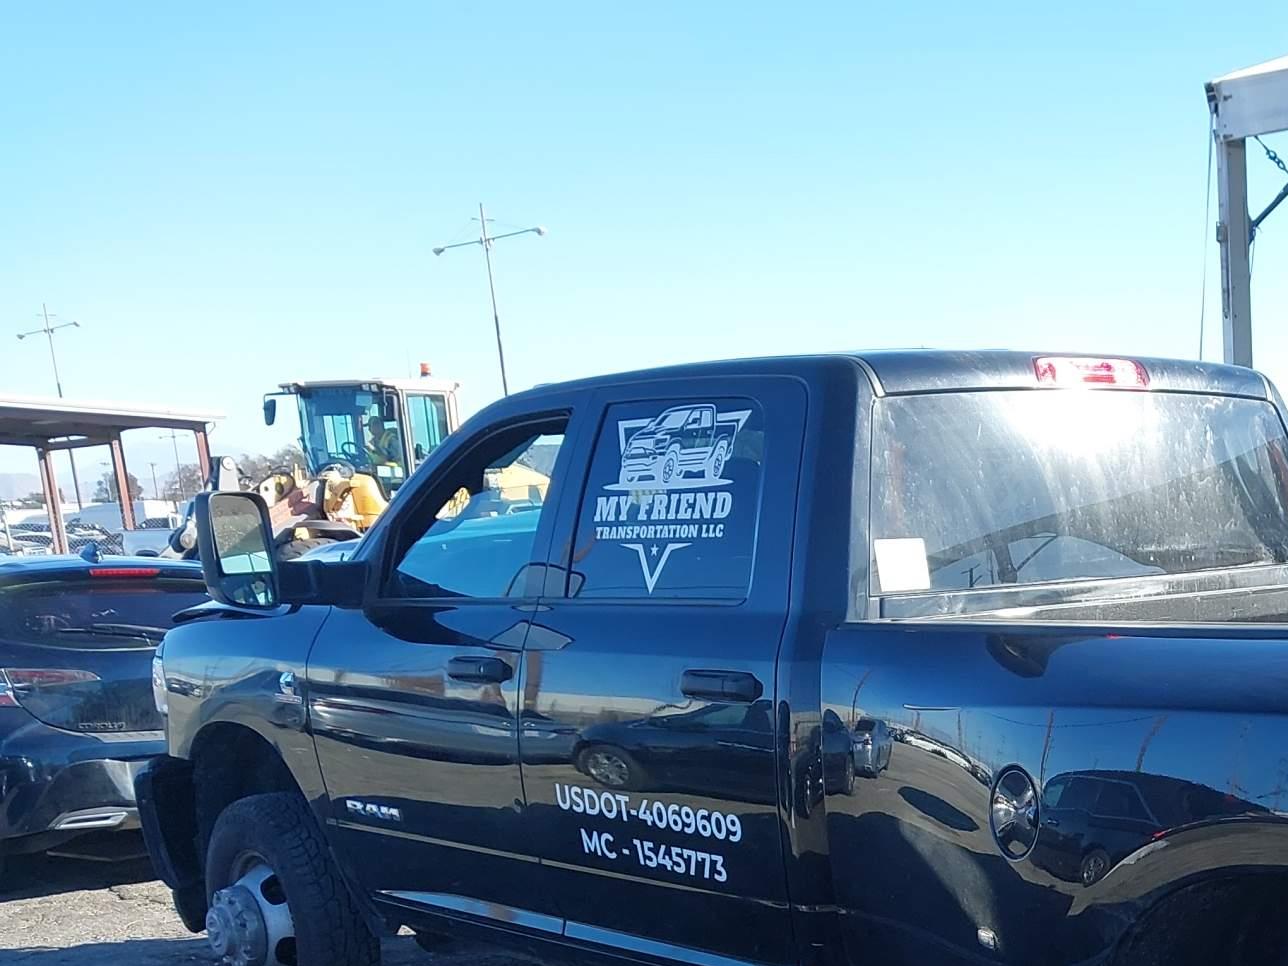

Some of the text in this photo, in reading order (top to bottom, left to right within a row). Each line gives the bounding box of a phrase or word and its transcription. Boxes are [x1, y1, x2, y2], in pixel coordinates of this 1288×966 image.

[594, 491, 732, 522] MY FRIEND
[595, 523, 724, 540] TRANSPORTATION LLC
[346, 799, 401, 822] RAM
[554, 782, 743, 843] USDOT-4069609
[580, 827, 617, 859] MC
[634, 838, 727, 883] 1545773
